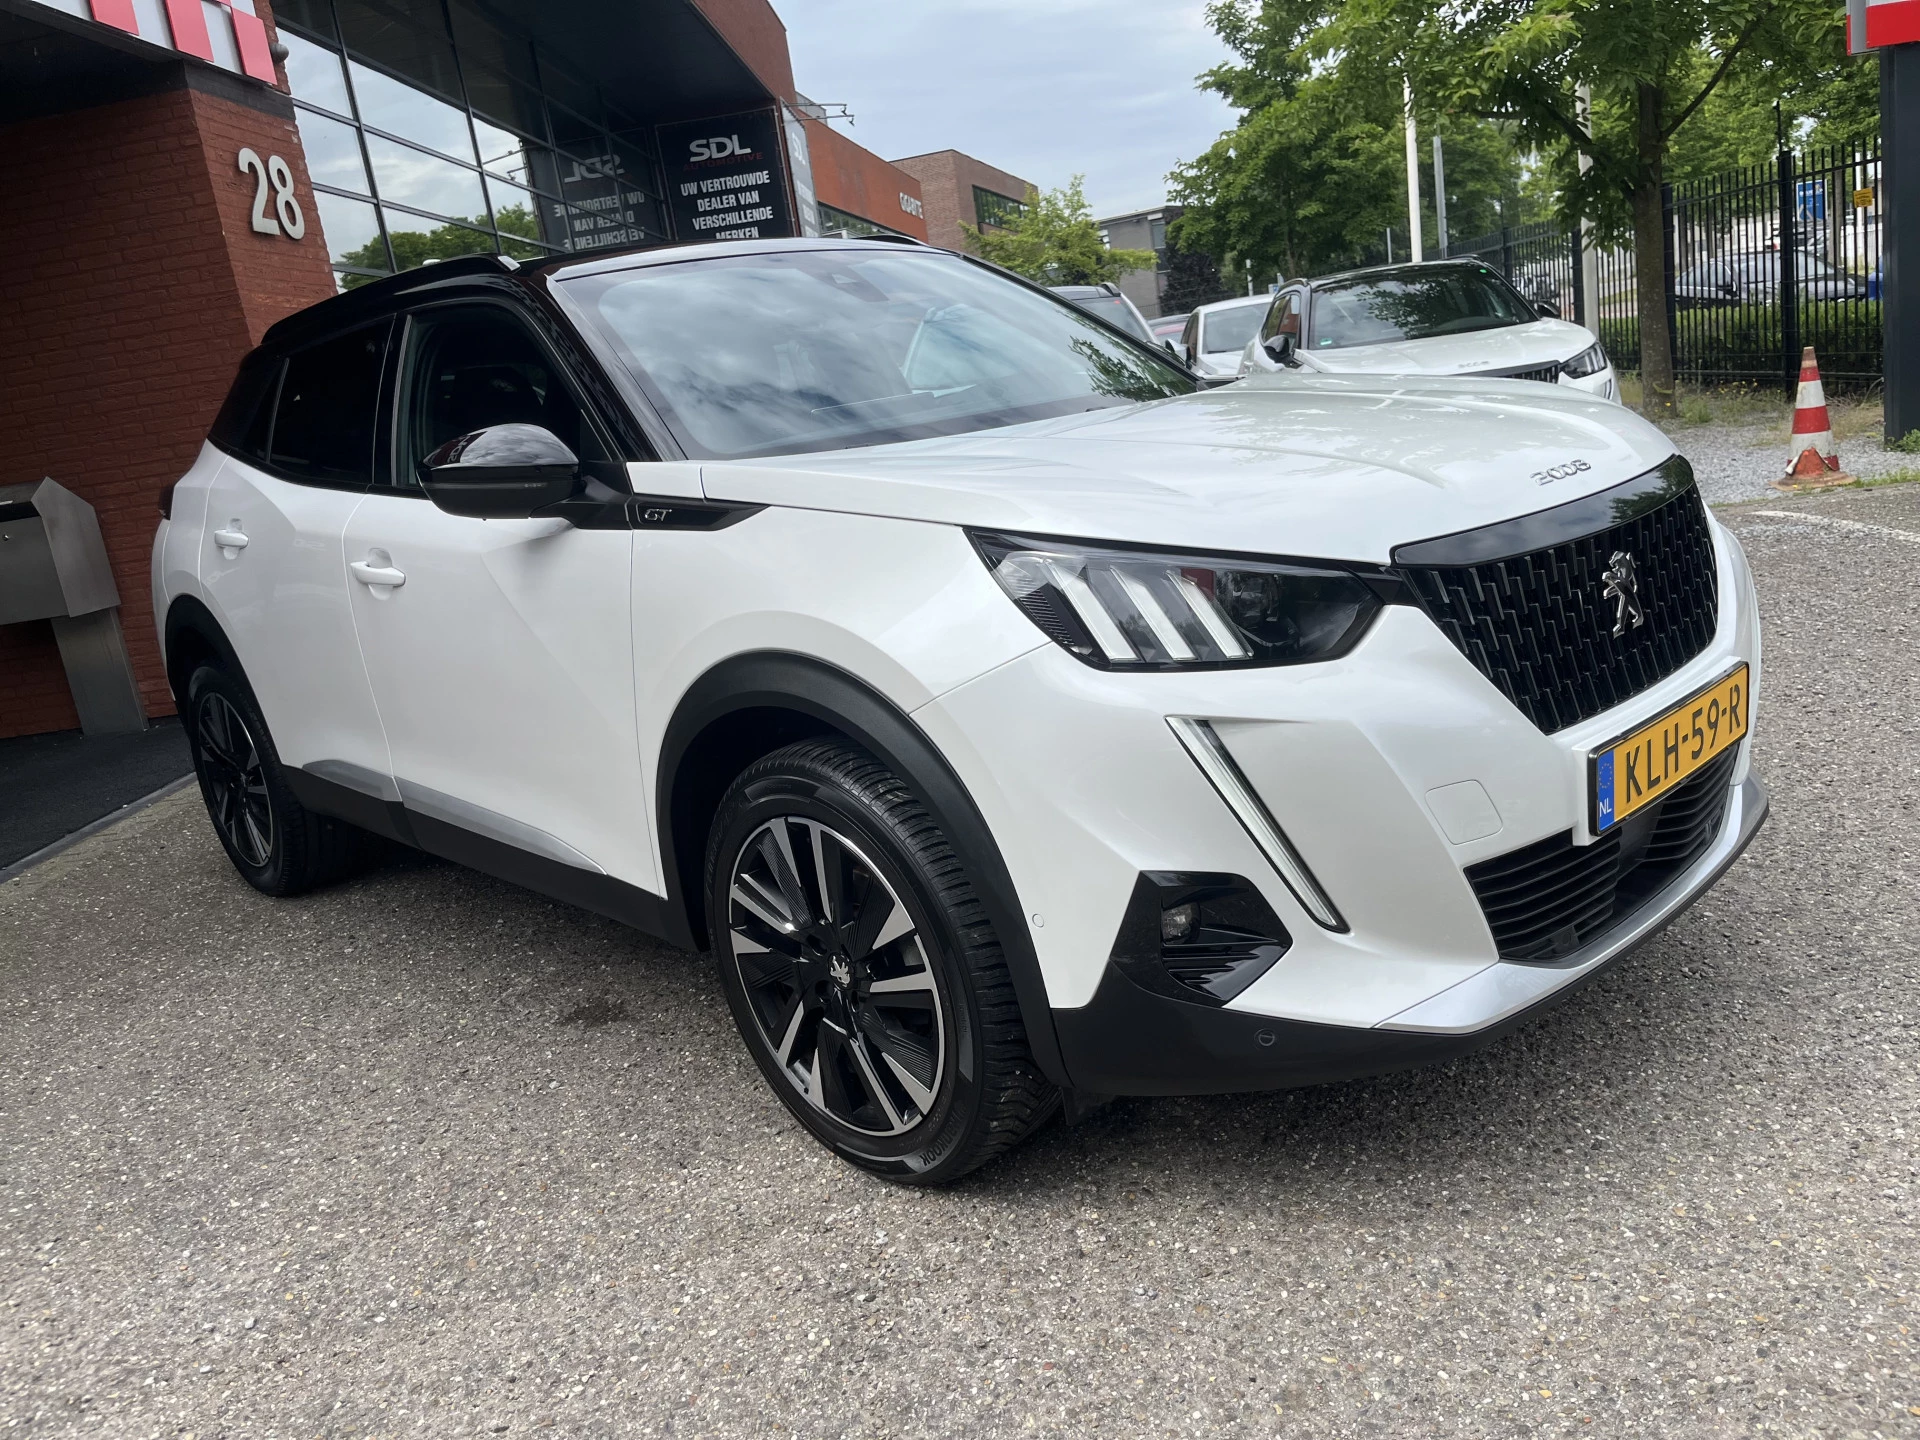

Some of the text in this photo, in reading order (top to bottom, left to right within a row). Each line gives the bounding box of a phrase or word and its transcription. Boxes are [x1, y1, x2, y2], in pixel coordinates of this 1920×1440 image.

[689, 133, 752, 162] SDL
[682, 152, 764, 172] AUTOMOTIVE
[238, 147, 305, 240] 28
[680, 170, 770, 197] UW VERTROUWDE
[697, 190, 760, 213] DEALER VAN
[692, 206, 774, 230] VERSCHILLENDE
[1529, 459, 1592, 486] 2008
[644, 508, 672, 521] GT
[1626, 683, 1741, 804] KLH-59-R
[1599, 797, 1612, 818] NL
